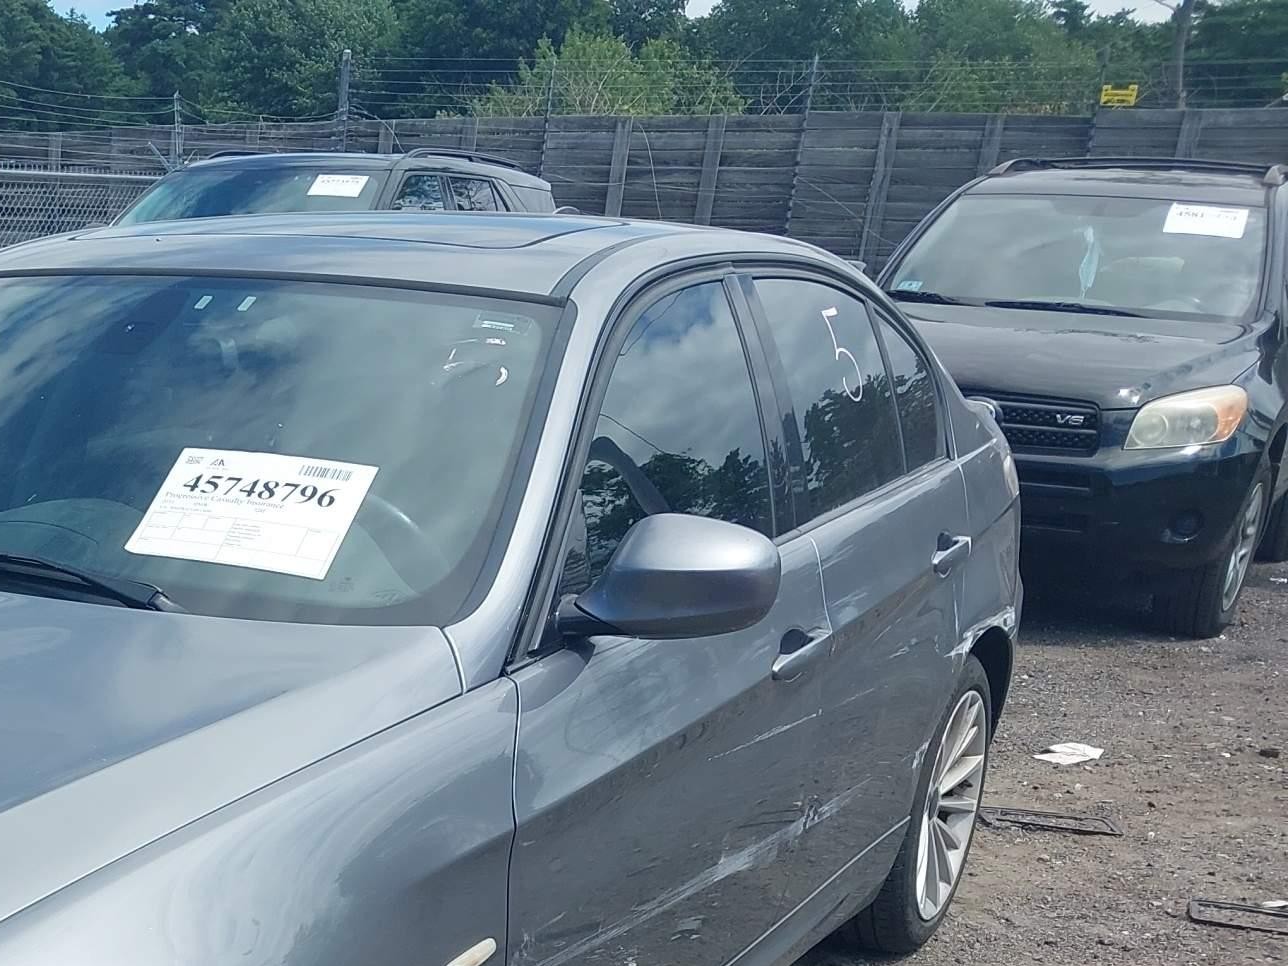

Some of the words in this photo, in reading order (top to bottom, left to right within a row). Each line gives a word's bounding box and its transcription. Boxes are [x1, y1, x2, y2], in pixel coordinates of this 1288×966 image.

[820, 306, 863, 402] 5
[1055, 413, 1085, 425] V6
[165, 490, 210, 501] Progressive
[210, 494, 245, 506] Casualty
[246, 499, 285, 510] Insurance
[183, 473, 342, 509] 45748796
